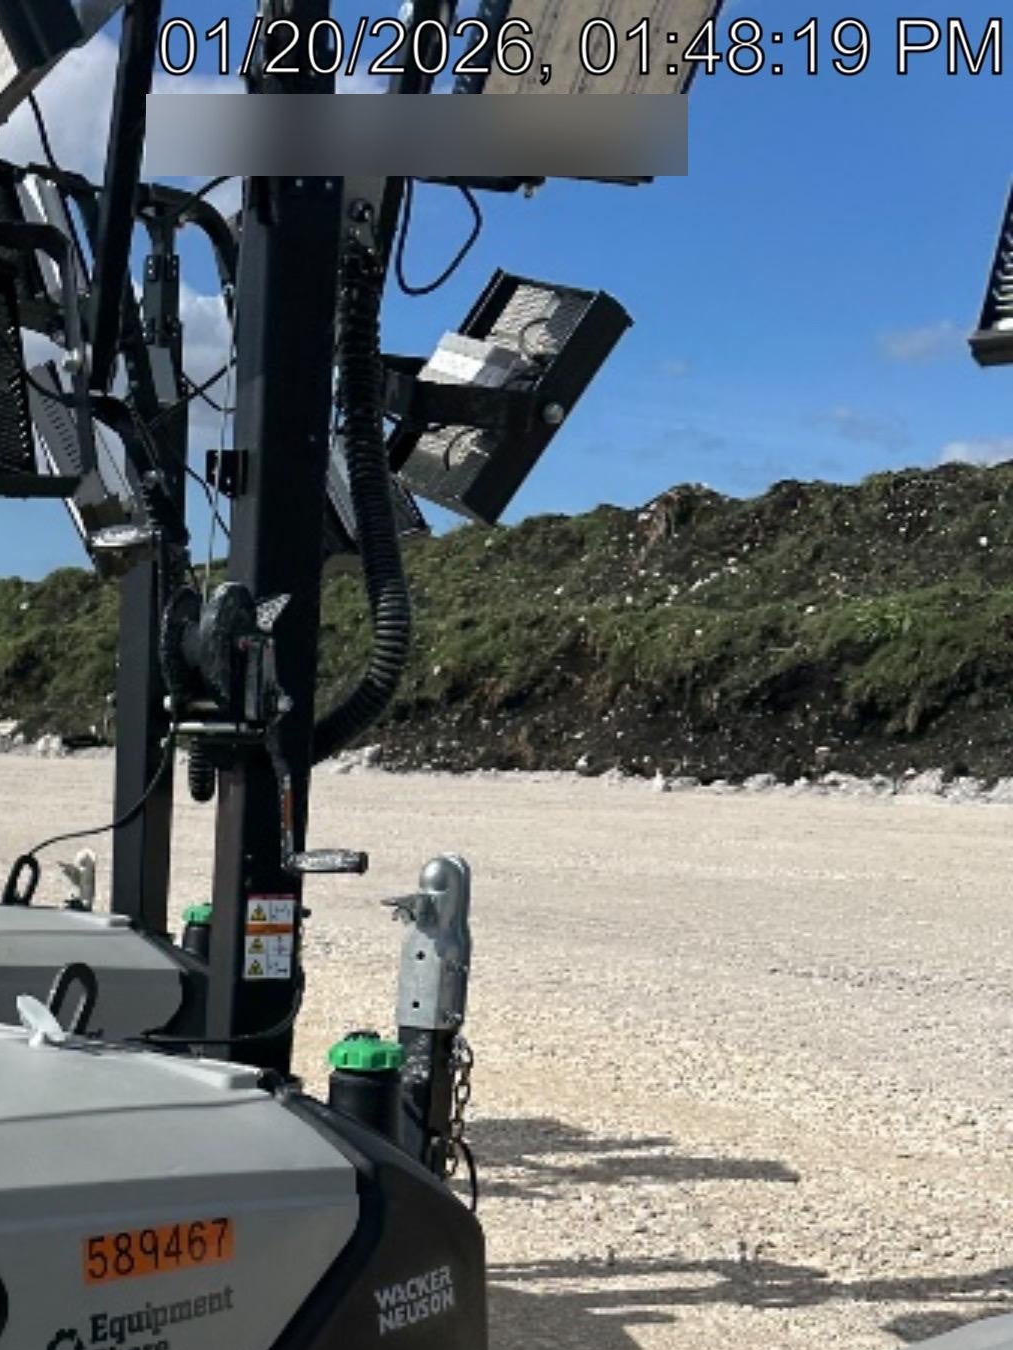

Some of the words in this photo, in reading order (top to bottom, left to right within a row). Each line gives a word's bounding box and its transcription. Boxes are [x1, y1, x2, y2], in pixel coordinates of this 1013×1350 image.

[88, 1217, 229, 1279] 589467
[89, 1285, 234, 1344] Equipment
[373, 1265, 453, 1311] WACKER
[378, 1286, 456, 1336] NEUSON
